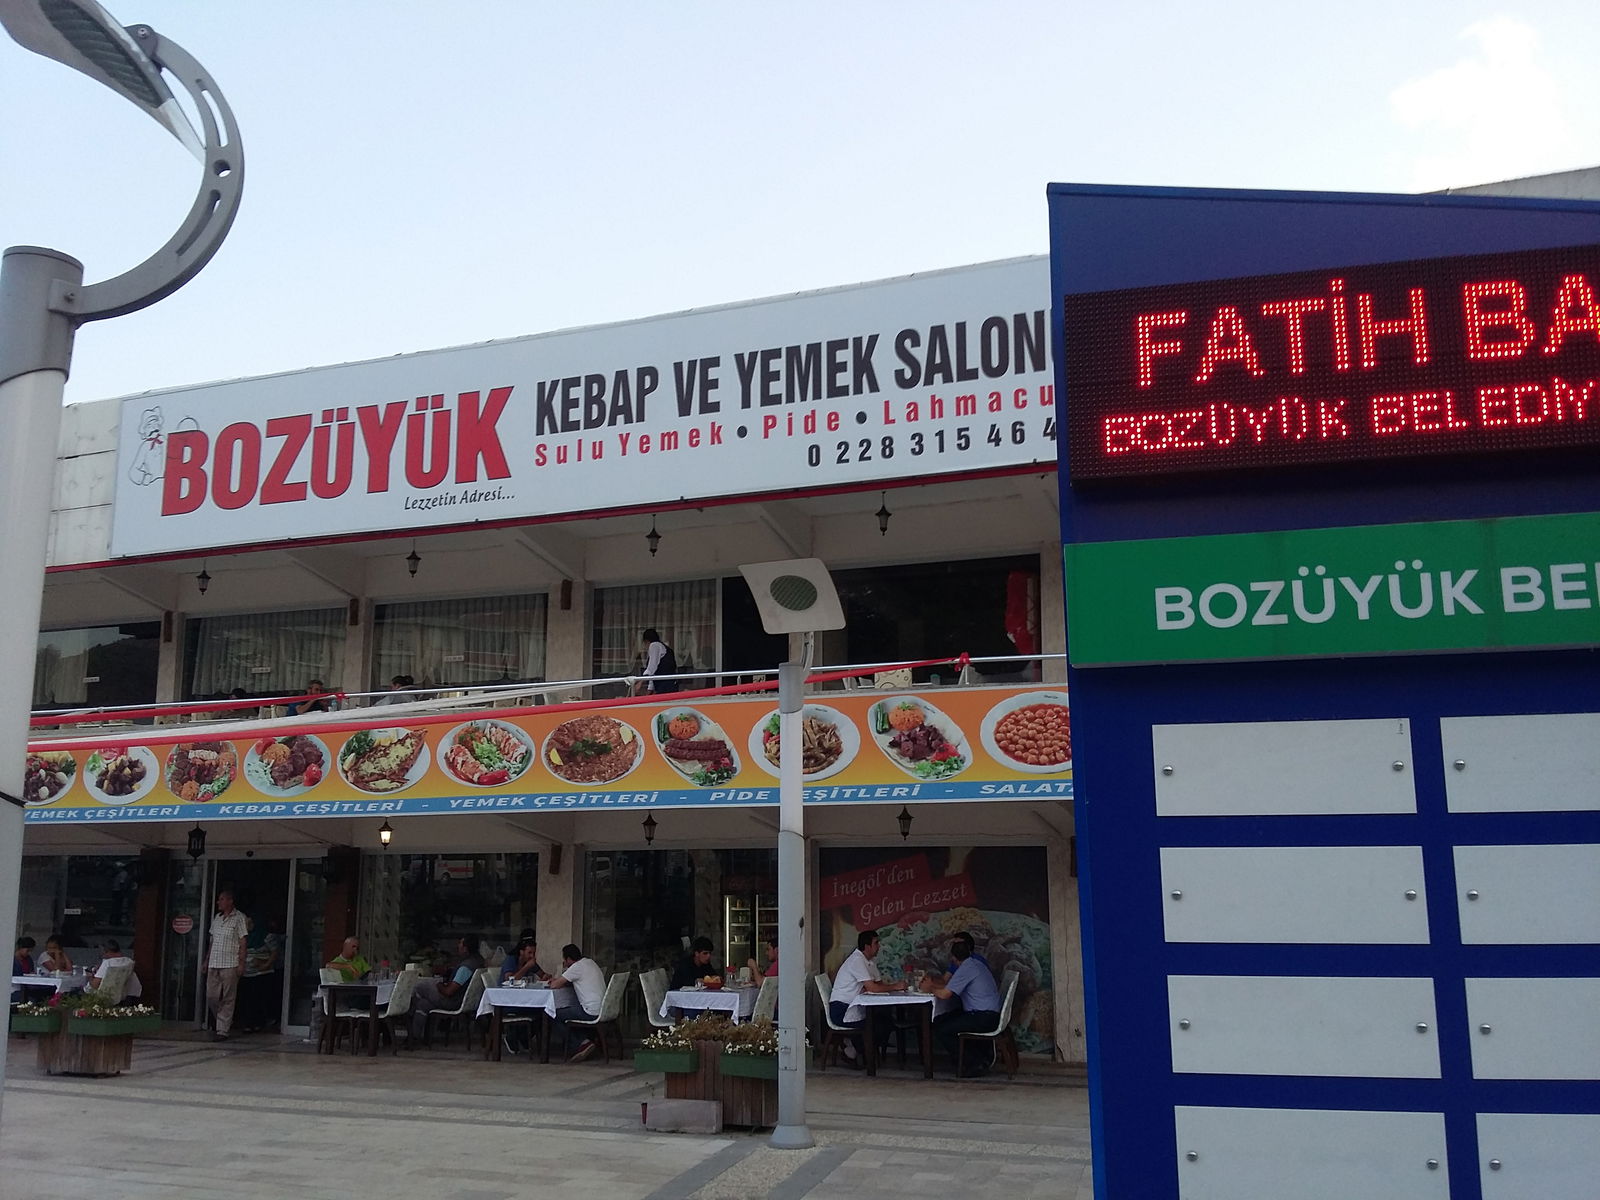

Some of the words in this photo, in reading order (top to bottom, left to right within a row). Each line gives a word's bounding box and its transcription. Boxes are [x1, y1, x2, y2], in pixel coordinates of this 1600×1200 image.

[1135, 279, 1429, 388] FATİH
[535, 365, 660, 437] KEBAP
[673, 356, 721, 418] VE
[733, 333, 880, 410] YEMEK
[161, 385, 515, 516] BOZÜYÜK
[534, 443, 603, 467] Sulu
[618, 422, 723, 457] Yemek
[762, 408, 841, 440] Pide
[807, 444, 820, 467] 0
[836, 433, 894, 464] 228
[910, 425, 970, 455] 315
[987, 421, 1025, 447] 46
[404, 491, 457, 511] Lezzetin
[1154, 559, 1485, 631] BOZÜYÜK
[84, 804, 181, 819] ÇEŞİTLERİ
[218, 802, 287, 815] KEBAP
[292, 799, 404, 815] ÇEŞİTLERİ
[449, 795, 526, 808] YEMEK
[534, 791, 659, 808] ÇEŞİTLERİ
[709, 788, 771, 801] PİDE
[803, 783, 921, 802] EŞİTLERİ
[979, 781, 1073, 795] SALAT
[858, 896, 905, 927] Gelen
[910, 881, 969, 911] Lezzet
